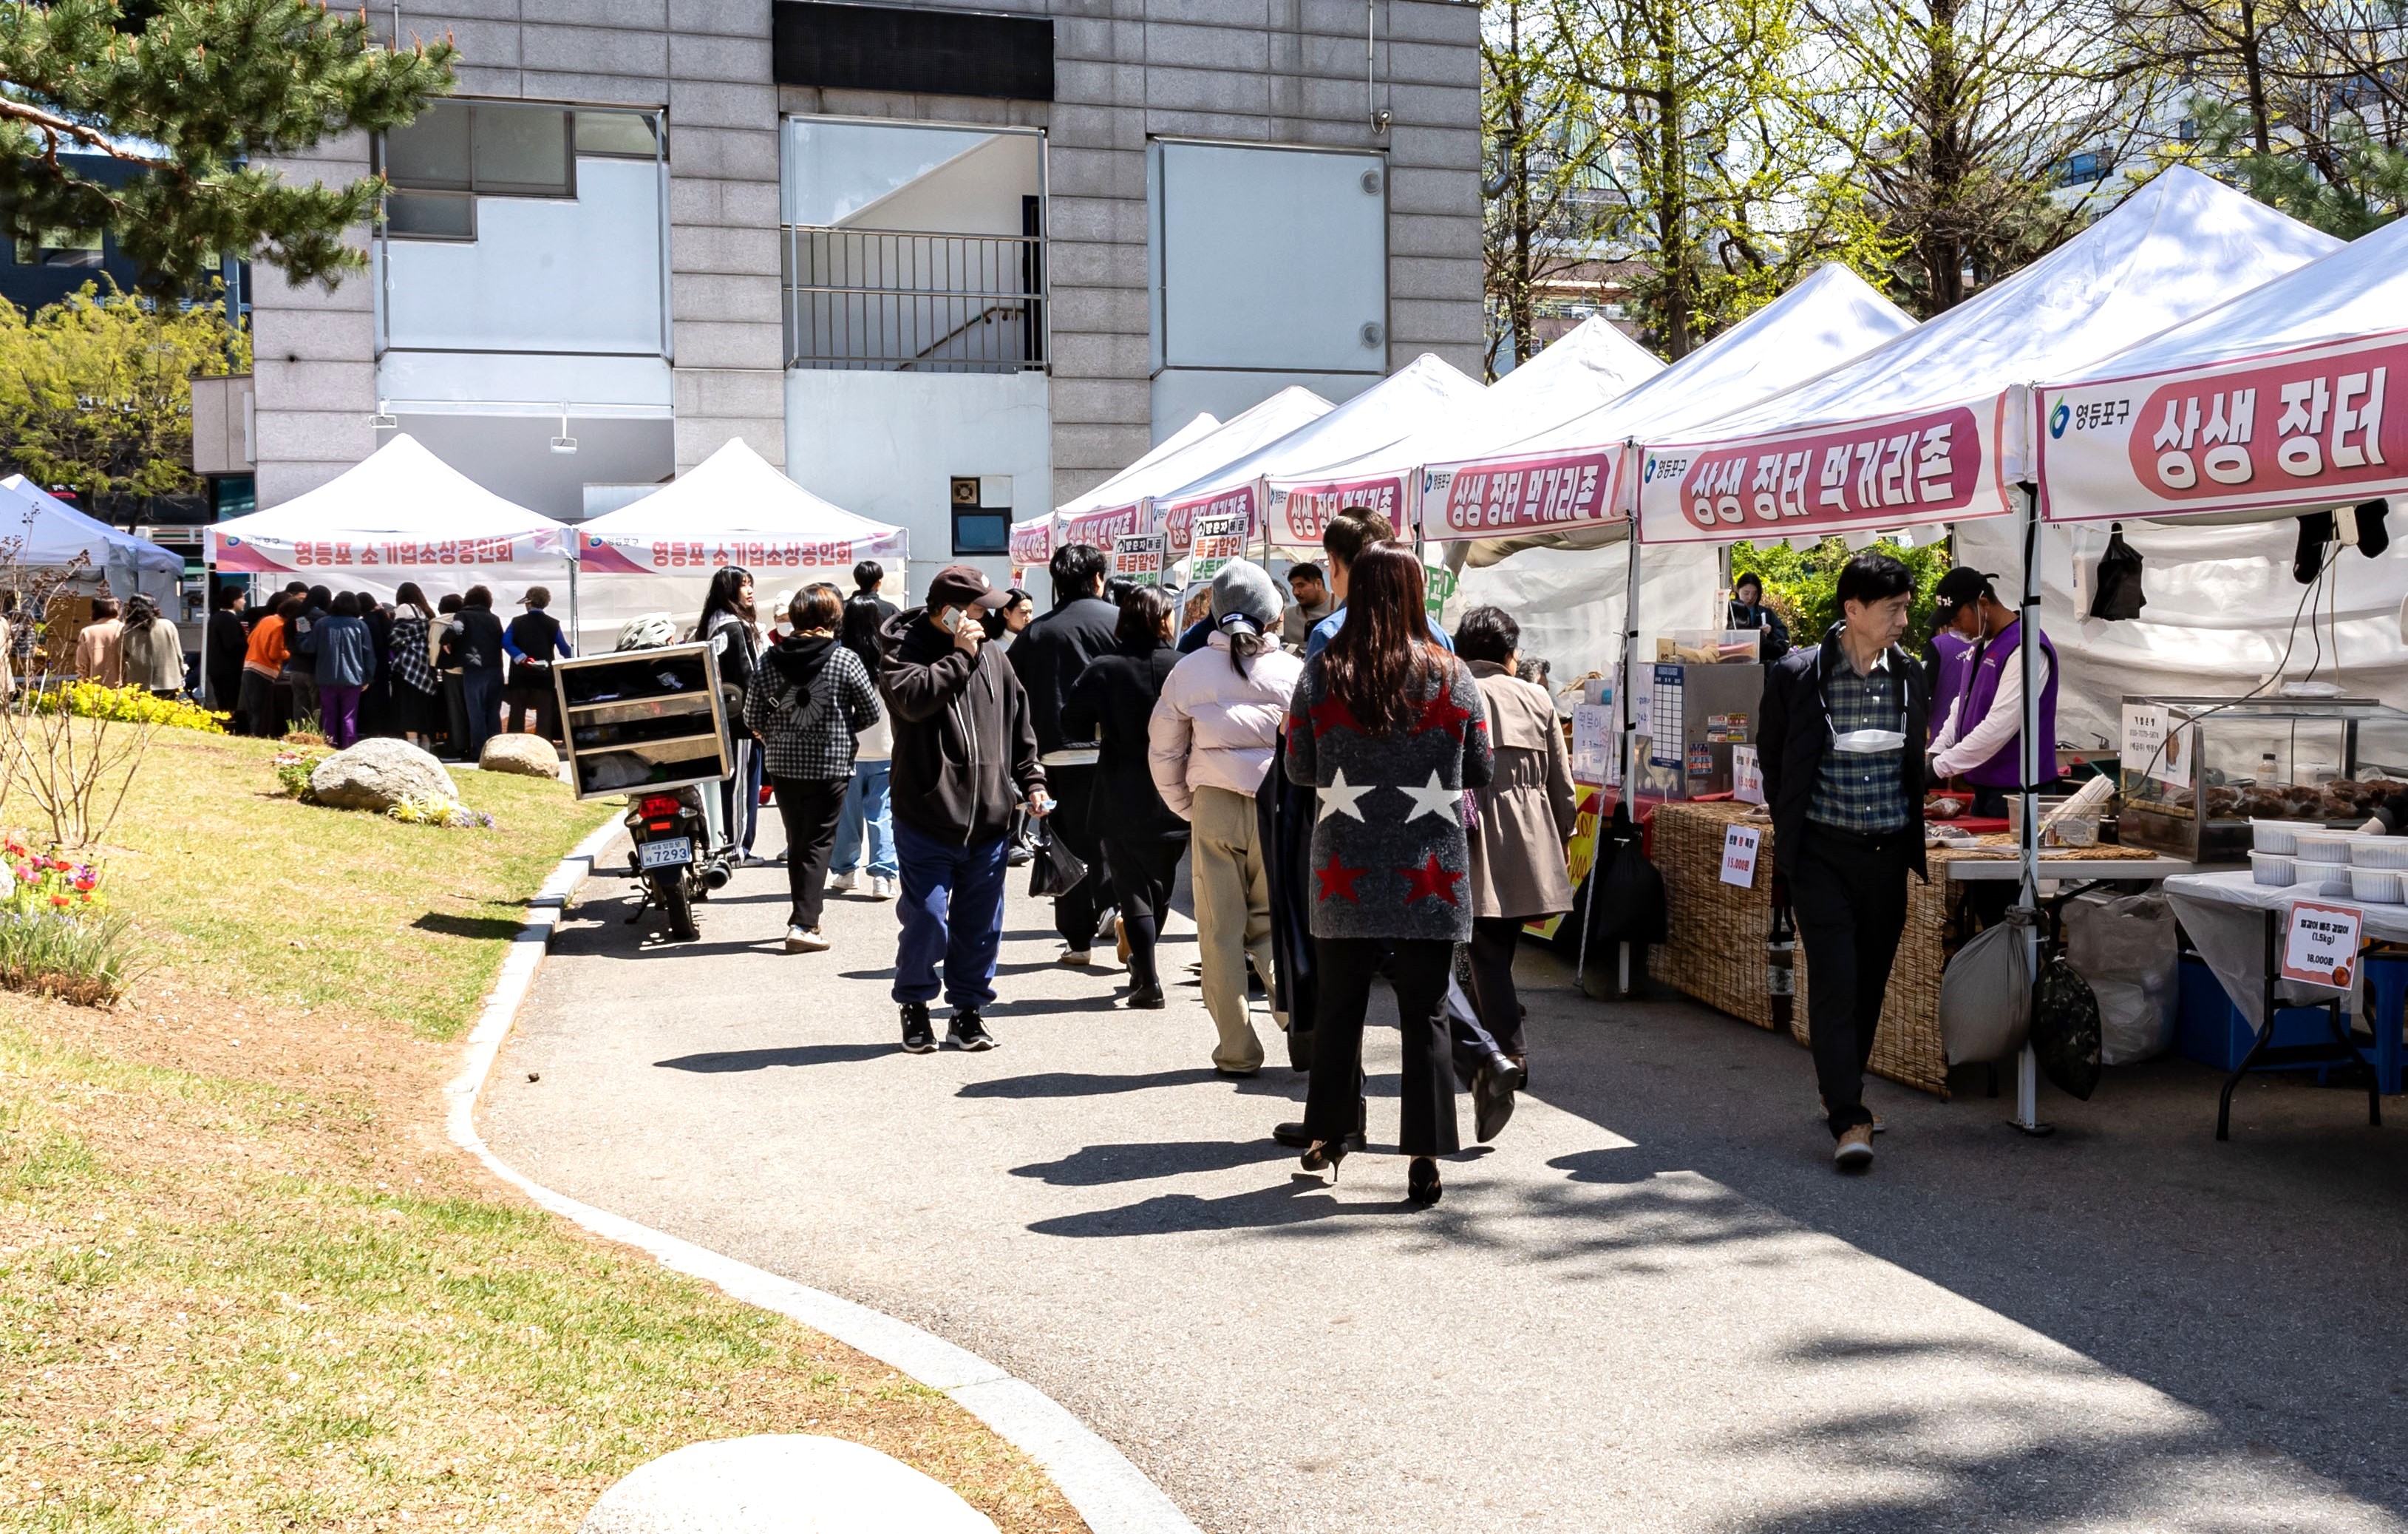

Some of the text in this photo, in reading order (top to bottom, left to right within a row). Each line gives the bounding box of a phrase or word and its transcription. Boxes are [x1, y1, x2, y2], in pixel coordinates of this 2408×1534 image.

[2075, 398, 2130, 431] 영등포구
[2153, 366, 2387, 490] 상생 장터
[1657, 458, 1687, 481] 영등포구
[1690, 421, 1954, 526] 상생 장터 먹거리존
[1452, 465, 1599, 528] 상생 장터 먹거리존
[1291, 493, 1316, 537] 상생
[295, 537, 514, 566] 영등포 소기업소상공인회
[652, 540, 853, 568] 영등포 소기업소상공인회
[1195, 535, 1242, 559] 특급할인
[1117, 553, 1160, 573] 특급할인
[654, 848, 687, 862] 7293
[2312, 931, 2336, 946] (1.5kg)
[2307, 953, 2334, 966] 18,000원
